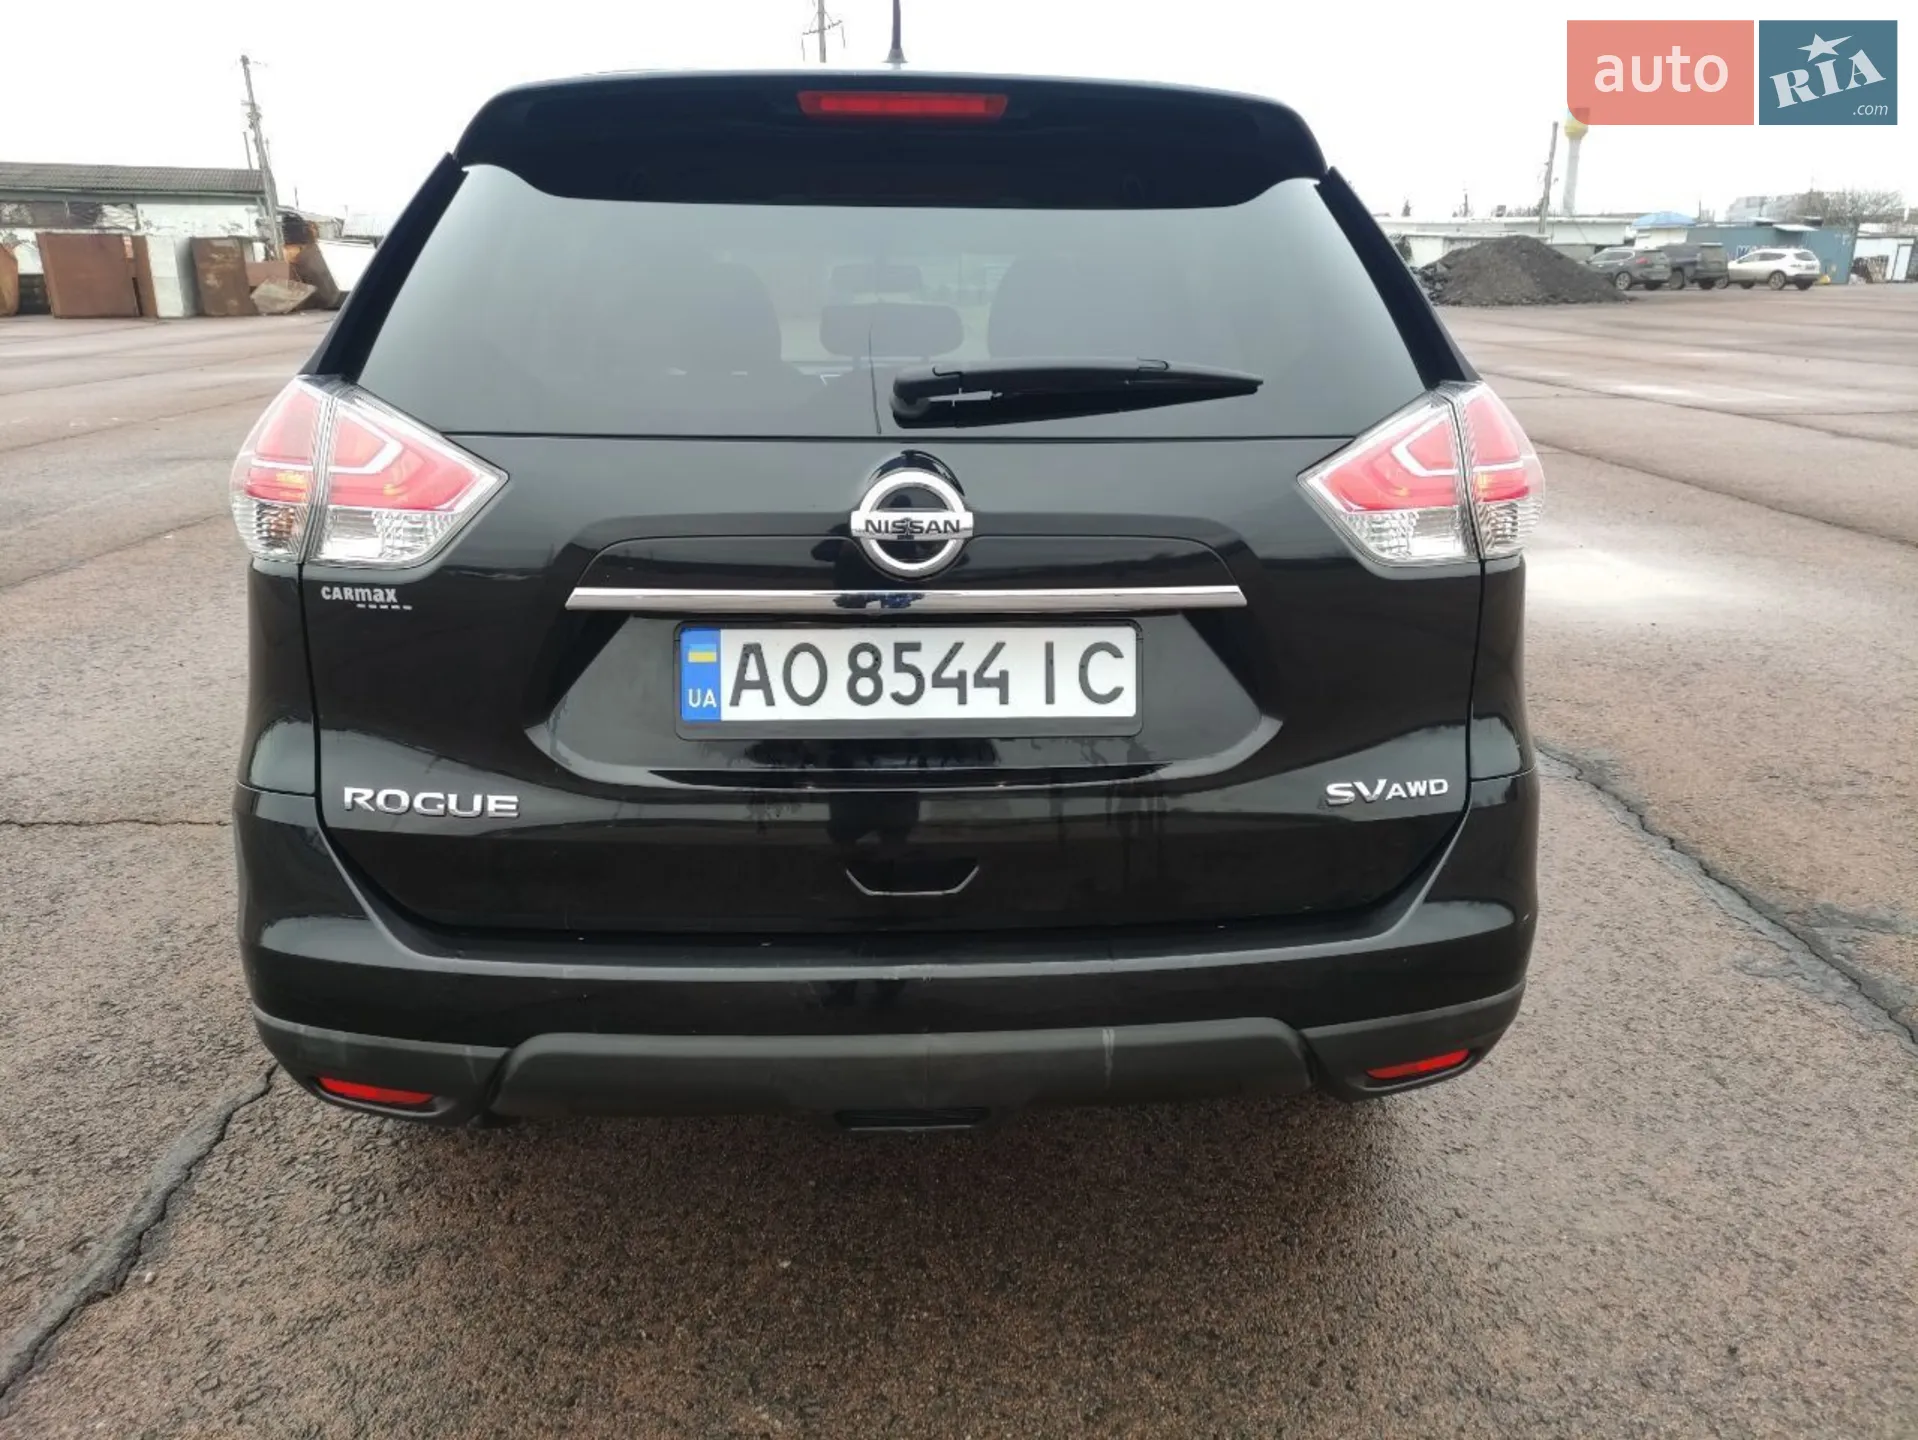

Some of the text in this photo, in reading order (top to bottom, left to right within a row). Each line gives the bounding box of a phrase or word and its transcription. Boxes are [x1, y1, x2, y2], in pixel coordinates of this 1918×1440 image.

[864, 518, 961, 535] NISSAN
[729, 641, 1125, 707] AO 8544 IC
[688, 688, 718, 708] UA
[343, 786, 520, 818] ROGUE
